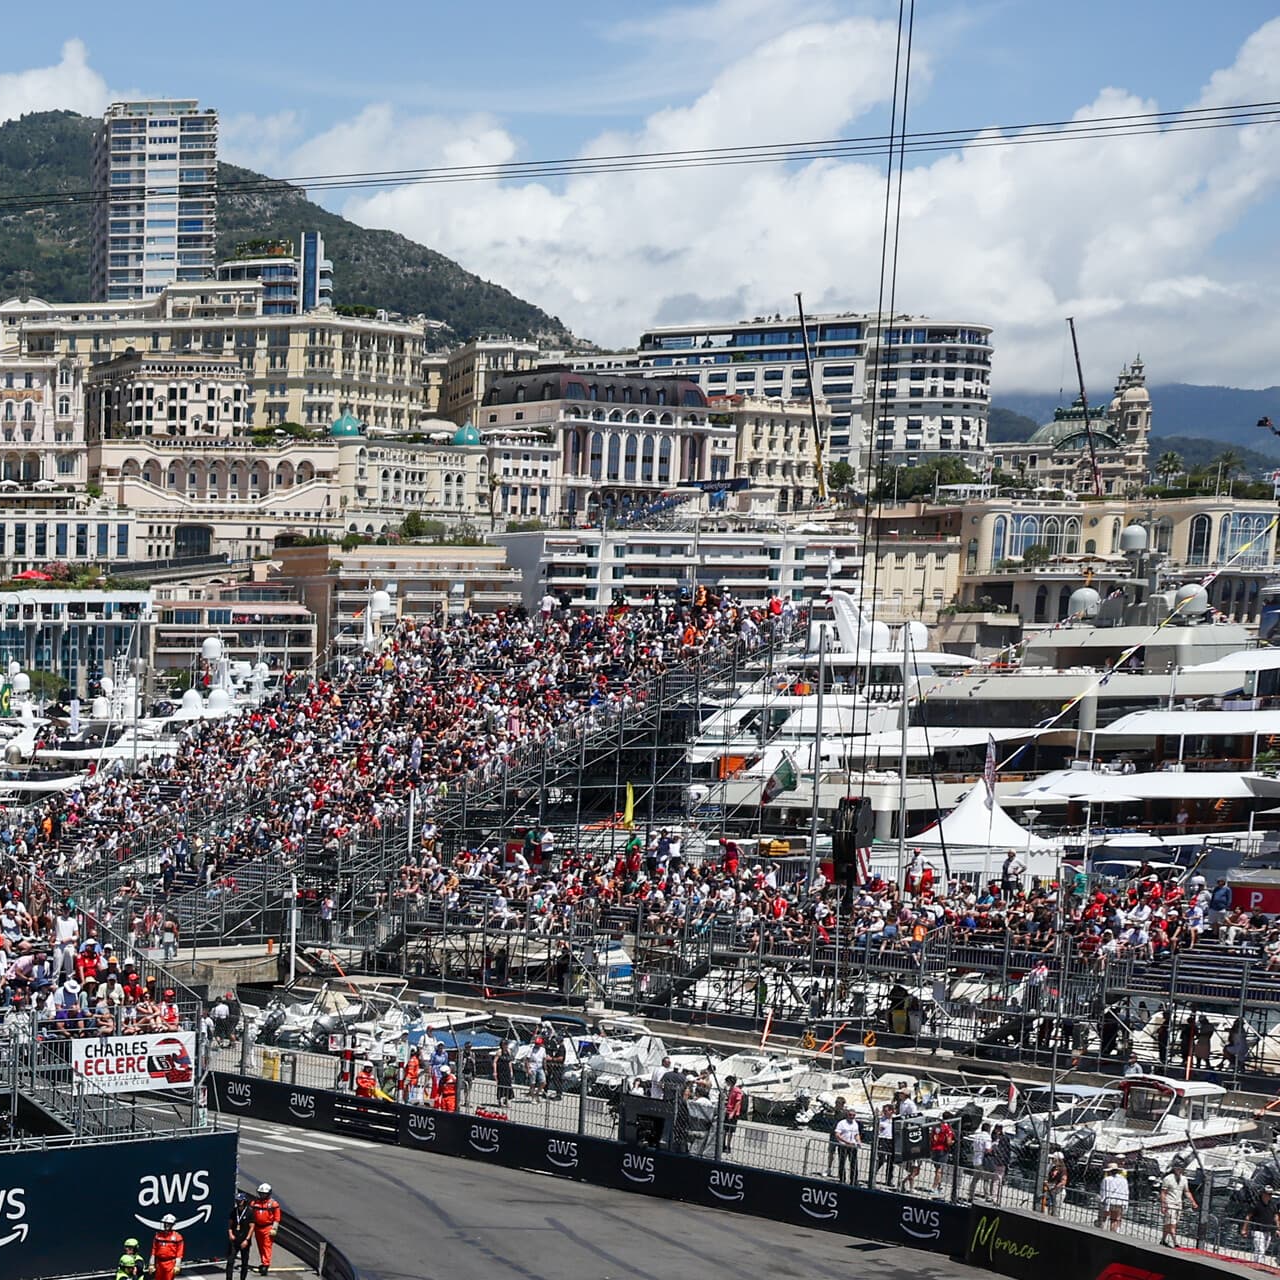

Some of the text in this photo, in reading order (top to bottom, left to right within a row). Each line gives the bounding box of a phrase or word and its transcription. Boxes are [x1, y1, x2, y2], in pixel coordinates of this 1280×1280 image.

[84, 1041, 148, 1058] CHARLES
[74, 1056, 146, 1076] LECLERC
[226, 1081, 252, 1098] aws
[290, 1092, 315, 1110] aws
[408, 1114, 436, 1131] aws
[471, 1125, 500, 1143] aws
[548, 1139, 578, 1158] aws
[622, 1152, 655, 1174] aws
[138, 1170, 210, 1208] aws
[709, 1169, 744, 1190] aws
[801, 1187, 838, 1209] aws
[902, 1205, 940, 1230] aws
[971, 1215, 1040, 1263] Monaco
